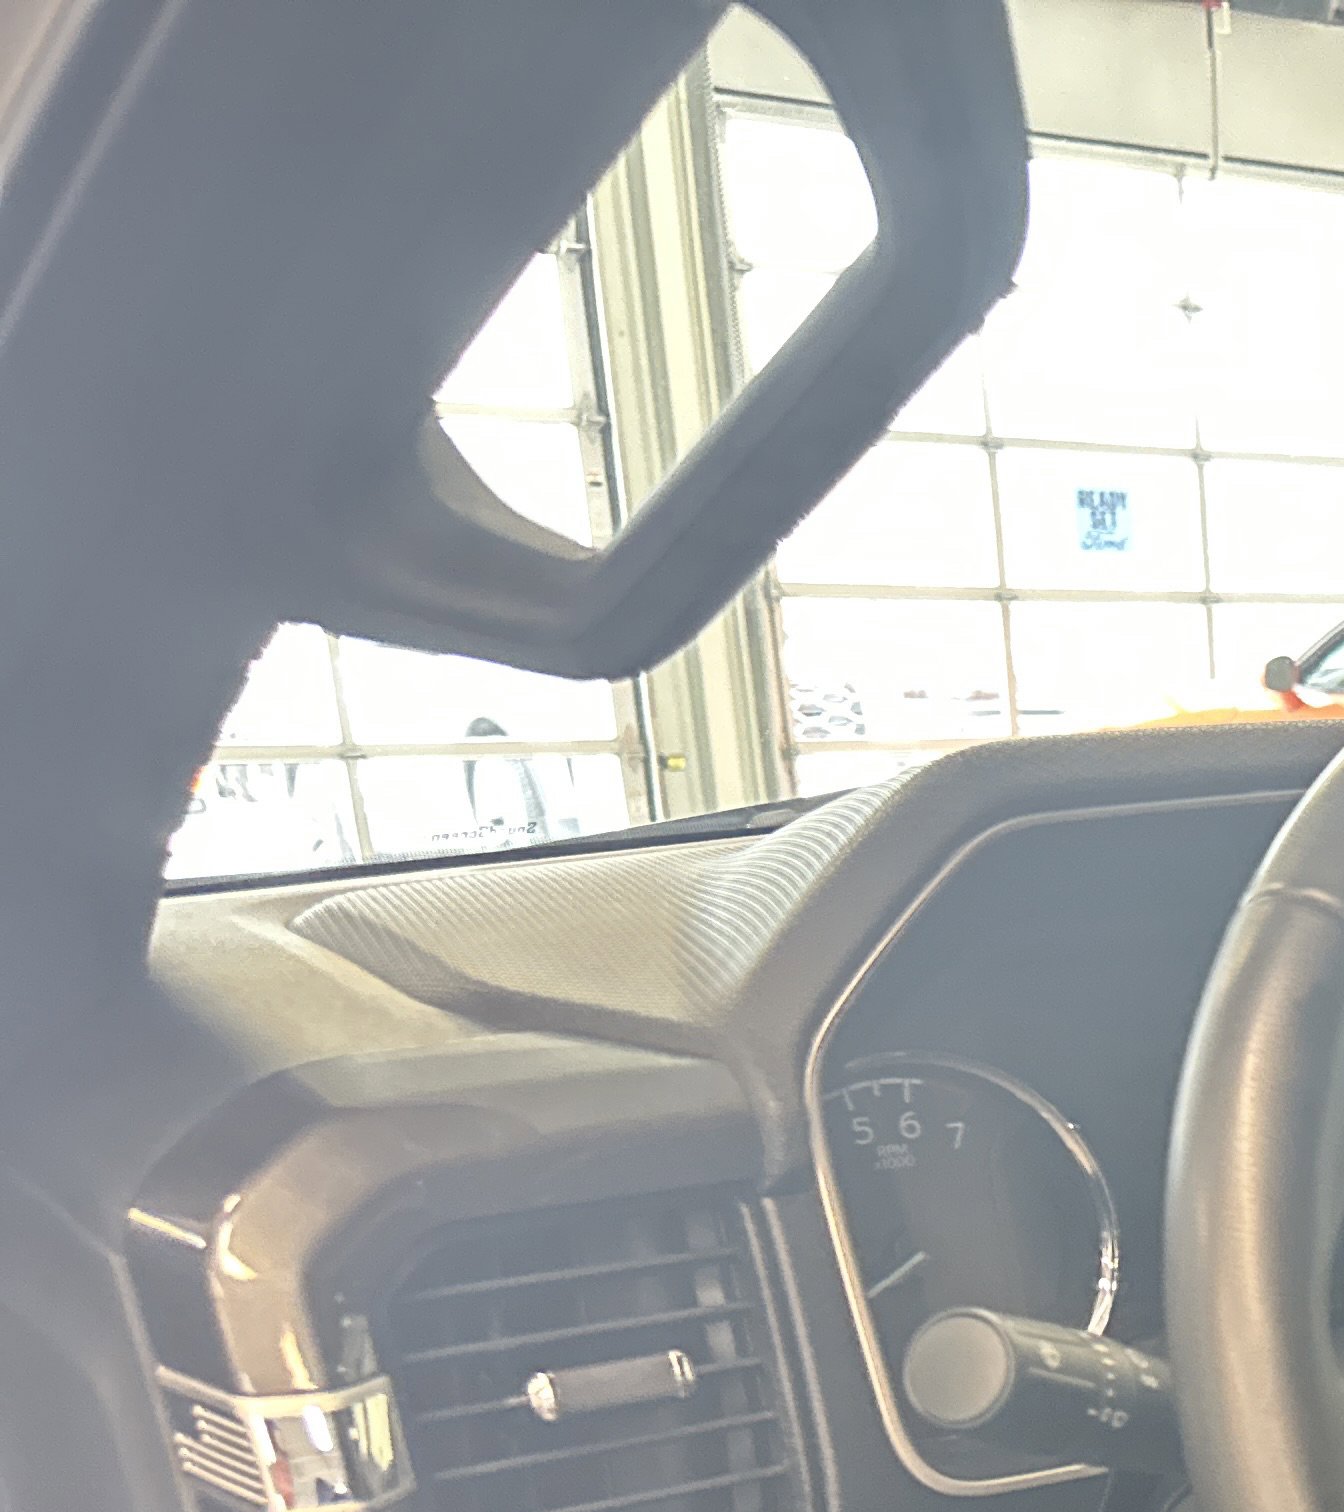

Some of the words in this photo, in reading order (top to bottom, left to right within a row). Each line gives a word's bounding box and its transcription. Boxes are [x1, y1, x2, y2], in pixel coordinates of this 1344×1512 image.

[852, 1116, 875, 1145] 5
[899, 1111, 922, 1139] 6
[945, 1121, 965, 1150] 7
